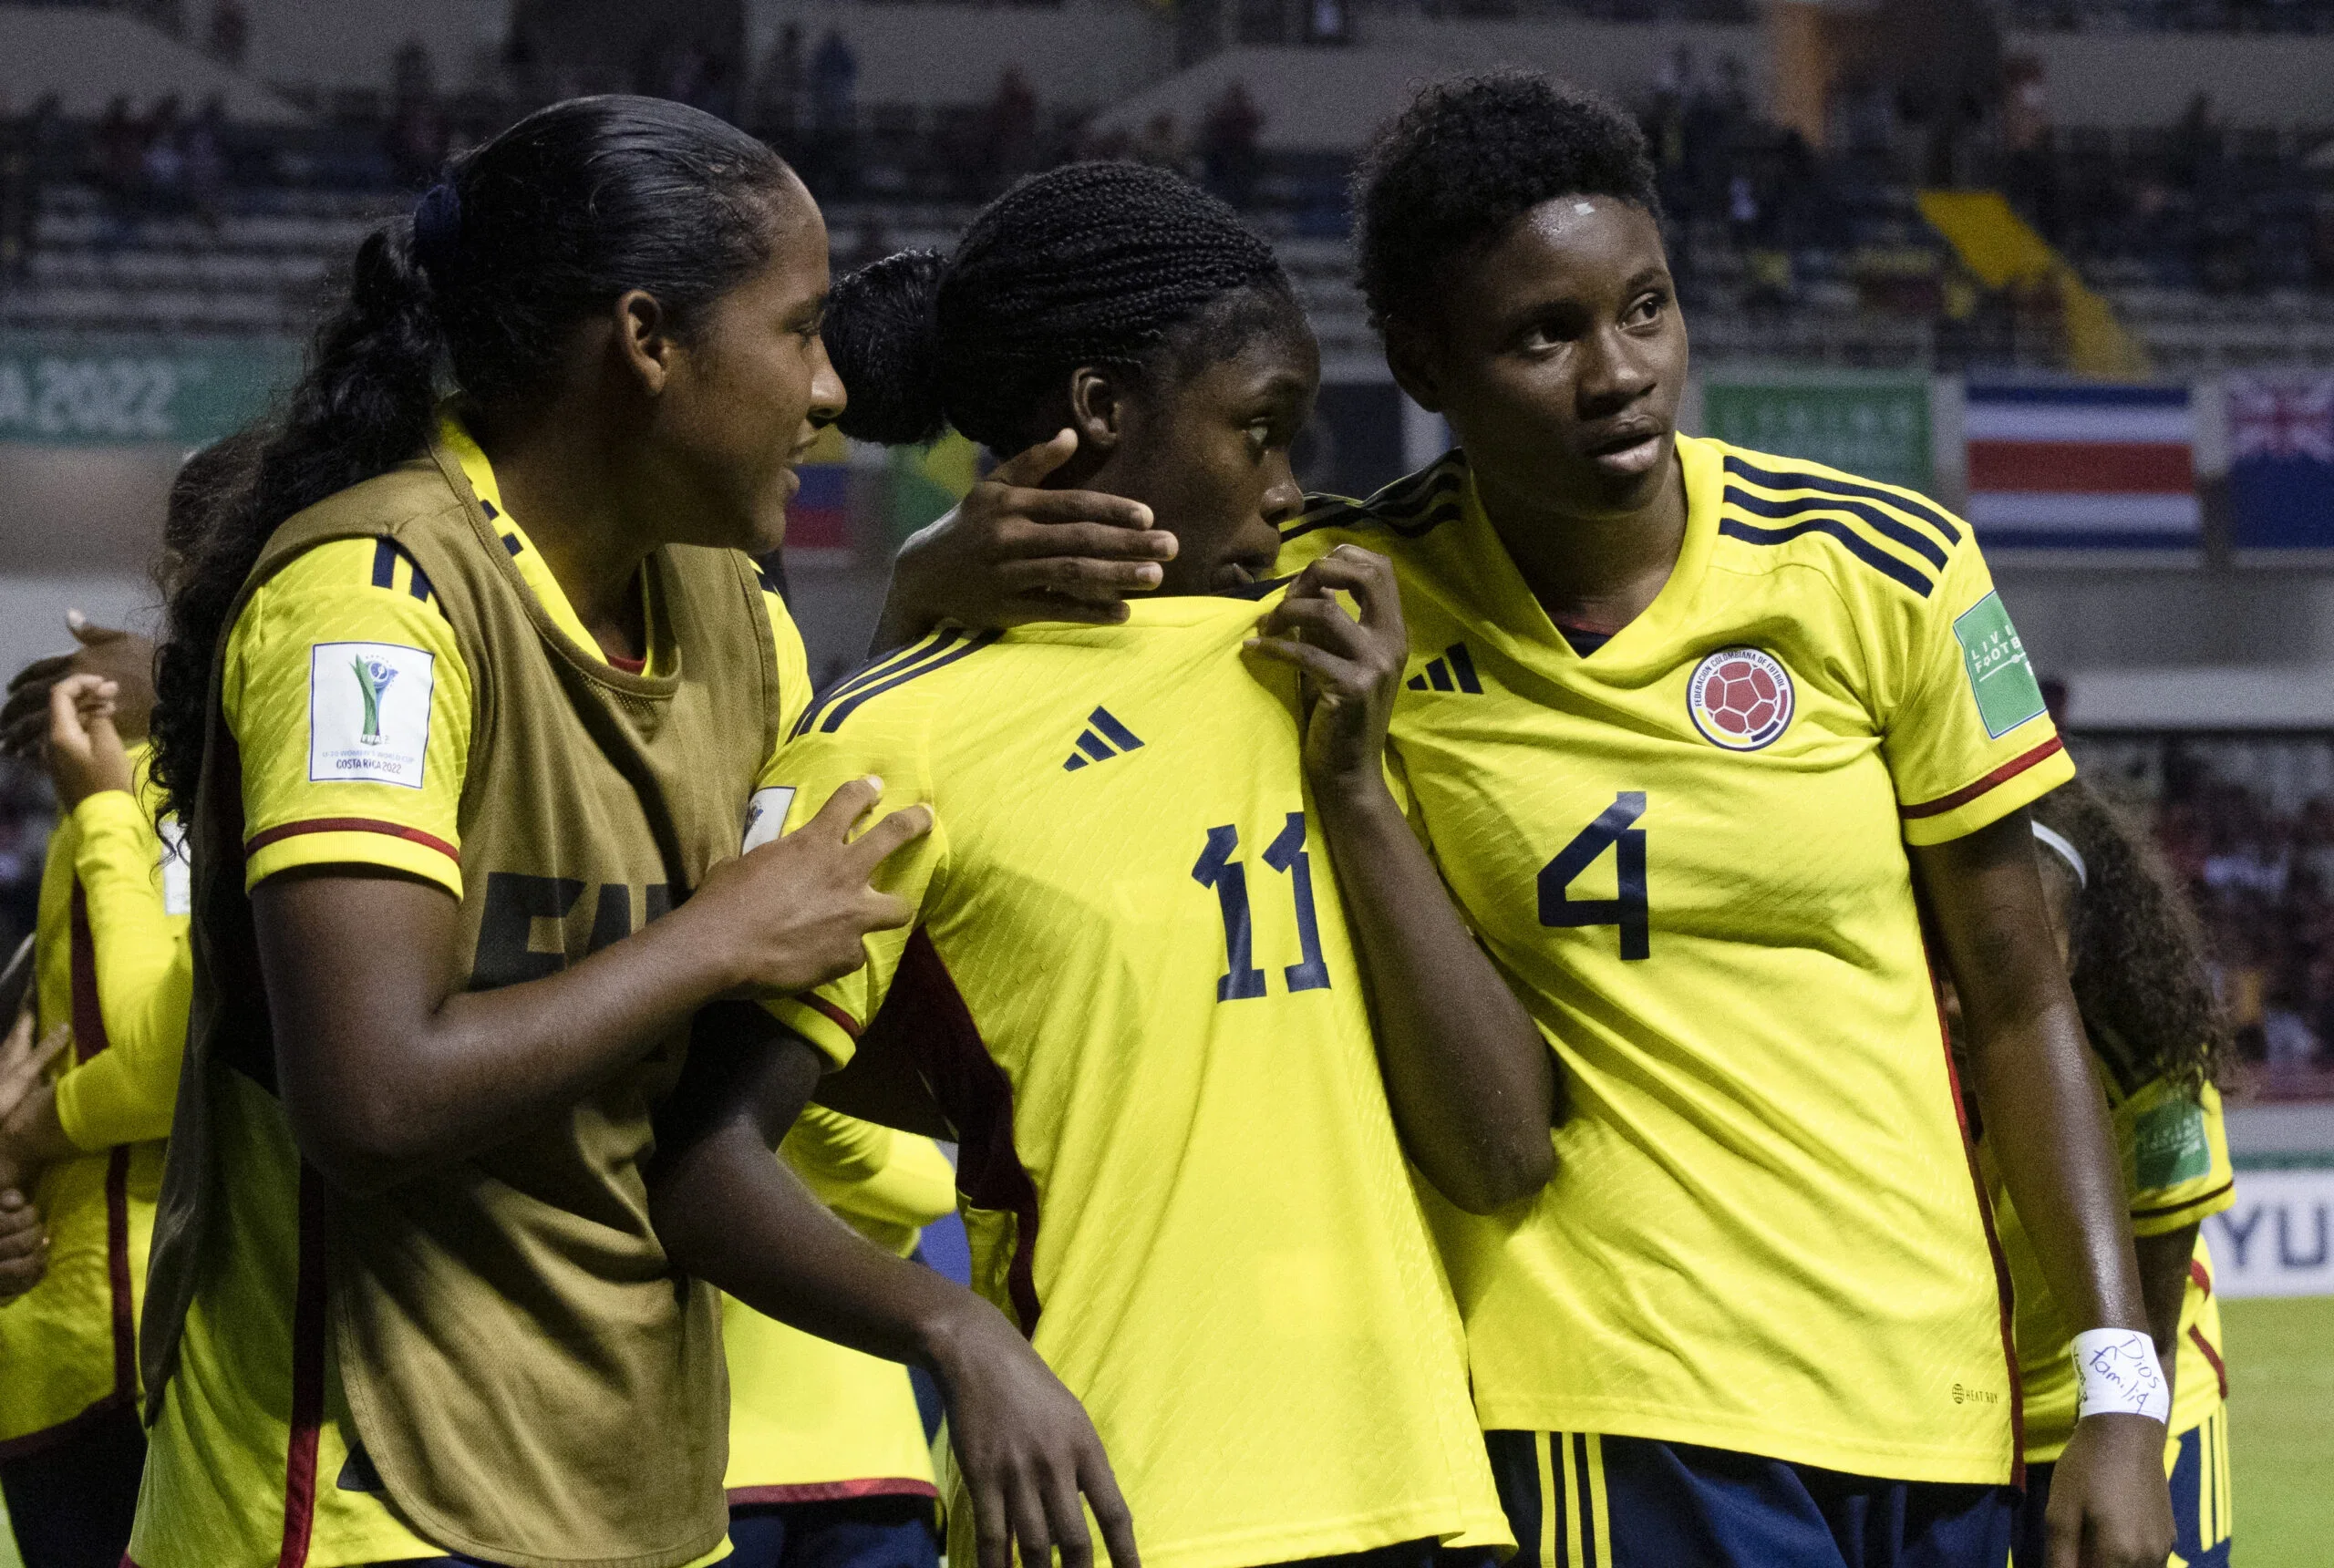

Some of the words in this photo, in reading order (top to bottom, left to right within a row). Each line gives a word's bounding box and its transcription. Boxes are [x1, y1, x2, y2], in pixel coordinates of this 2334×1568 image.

[38, 357, 177, 433] 2022
[1710, 651, 1756, 667] COLOMBIANA
[1757, 655, 1768, 665] DE
[1766, 663, 1785, 687] FUTBOL
[336, 758, 361, 769] COSTA
[363, 758, 381, 769] RICA
[382, 762, 402, 774] 2022
[1192, 811, 1332, 1004] 11
[1536, 790, 1650, 961] 4
